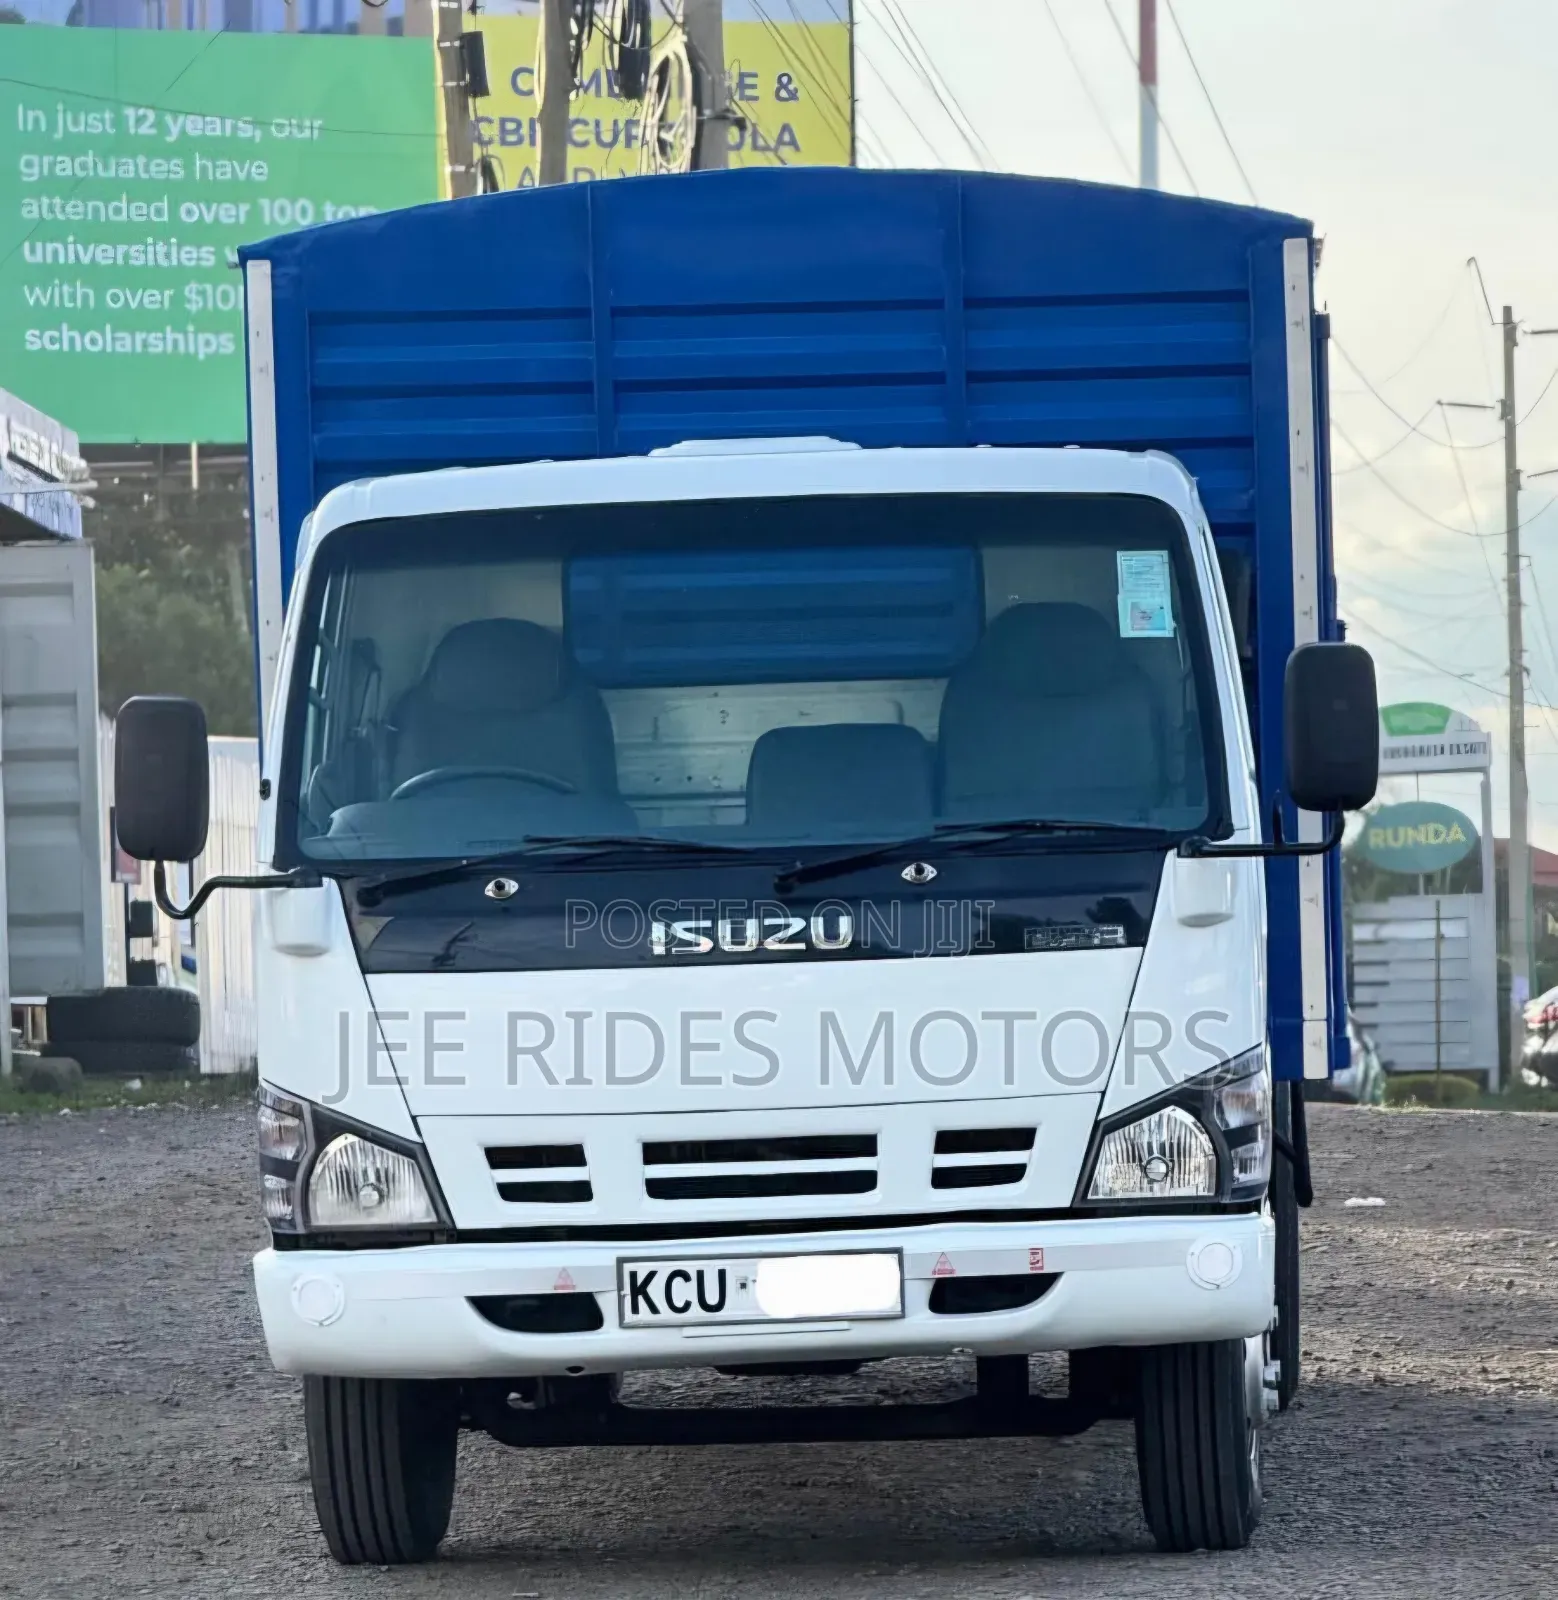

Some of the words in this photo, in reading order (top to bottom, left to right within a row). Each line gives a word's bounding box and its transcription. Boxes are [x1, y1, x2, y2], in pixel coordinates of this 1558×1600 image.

[17, 104, 47, 132] In
[53, 102, 116, 140] just
[124, 107, 157, 134] 12
[164, 113, 262, 143] years,
[270, 117, 323, 140] our
[19, 150, 185, 182] graduates
[195, 152, 269, 181] have
[20, 192, 169, 222] attended
[179, 200, 251, 223] over
[257, 198, 314, 225] 100
[23, 235, 216, 268] universities
[23, 279, 95, 309] with
[106, 287, 174, 310] over
[184, 280, 245, 314] $10
[24, 322, 236, 360] scholarships
[1369, 821, 1467, 850] RUNDA
[651, 914, 854, 956] ISUZU
[628, 1267, 728, 1316] KCU
